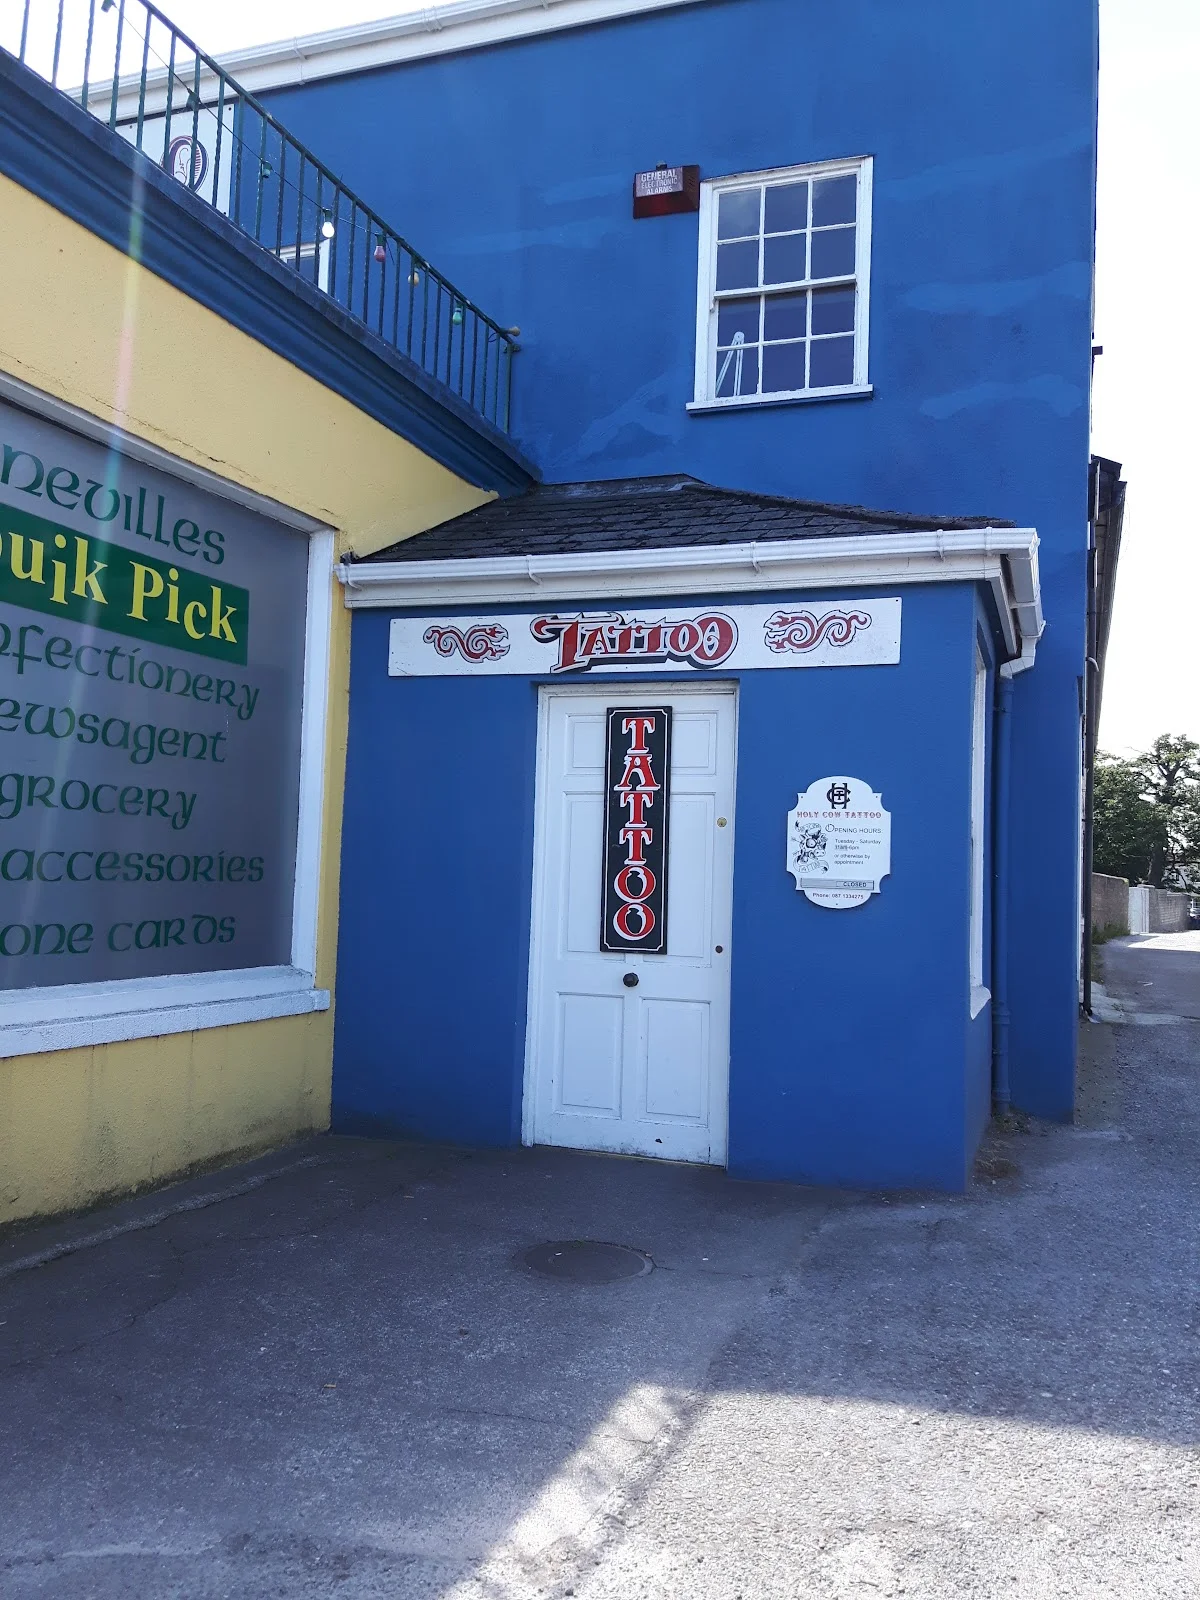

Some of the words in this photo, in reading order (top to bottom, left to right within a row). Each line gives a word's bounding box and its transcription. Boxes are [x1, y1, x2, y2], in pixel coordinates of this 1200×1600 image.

[641, 169, 677, 182] GENERAL
[641, 177, 677, 189] ELECTRONIC
[646, 185, 673, 195] ALARMS
[0, 530, 108, 605] uik
[126, 561, 238, 644] Pick
[845, 811, 882, 819] TATTOO
[613, 717, 661, 940] TATTOO
[825, 823, 857, 834] OPENING
[1, 849, 265, 882] accessories
[107, 914, 236, 952] cards
